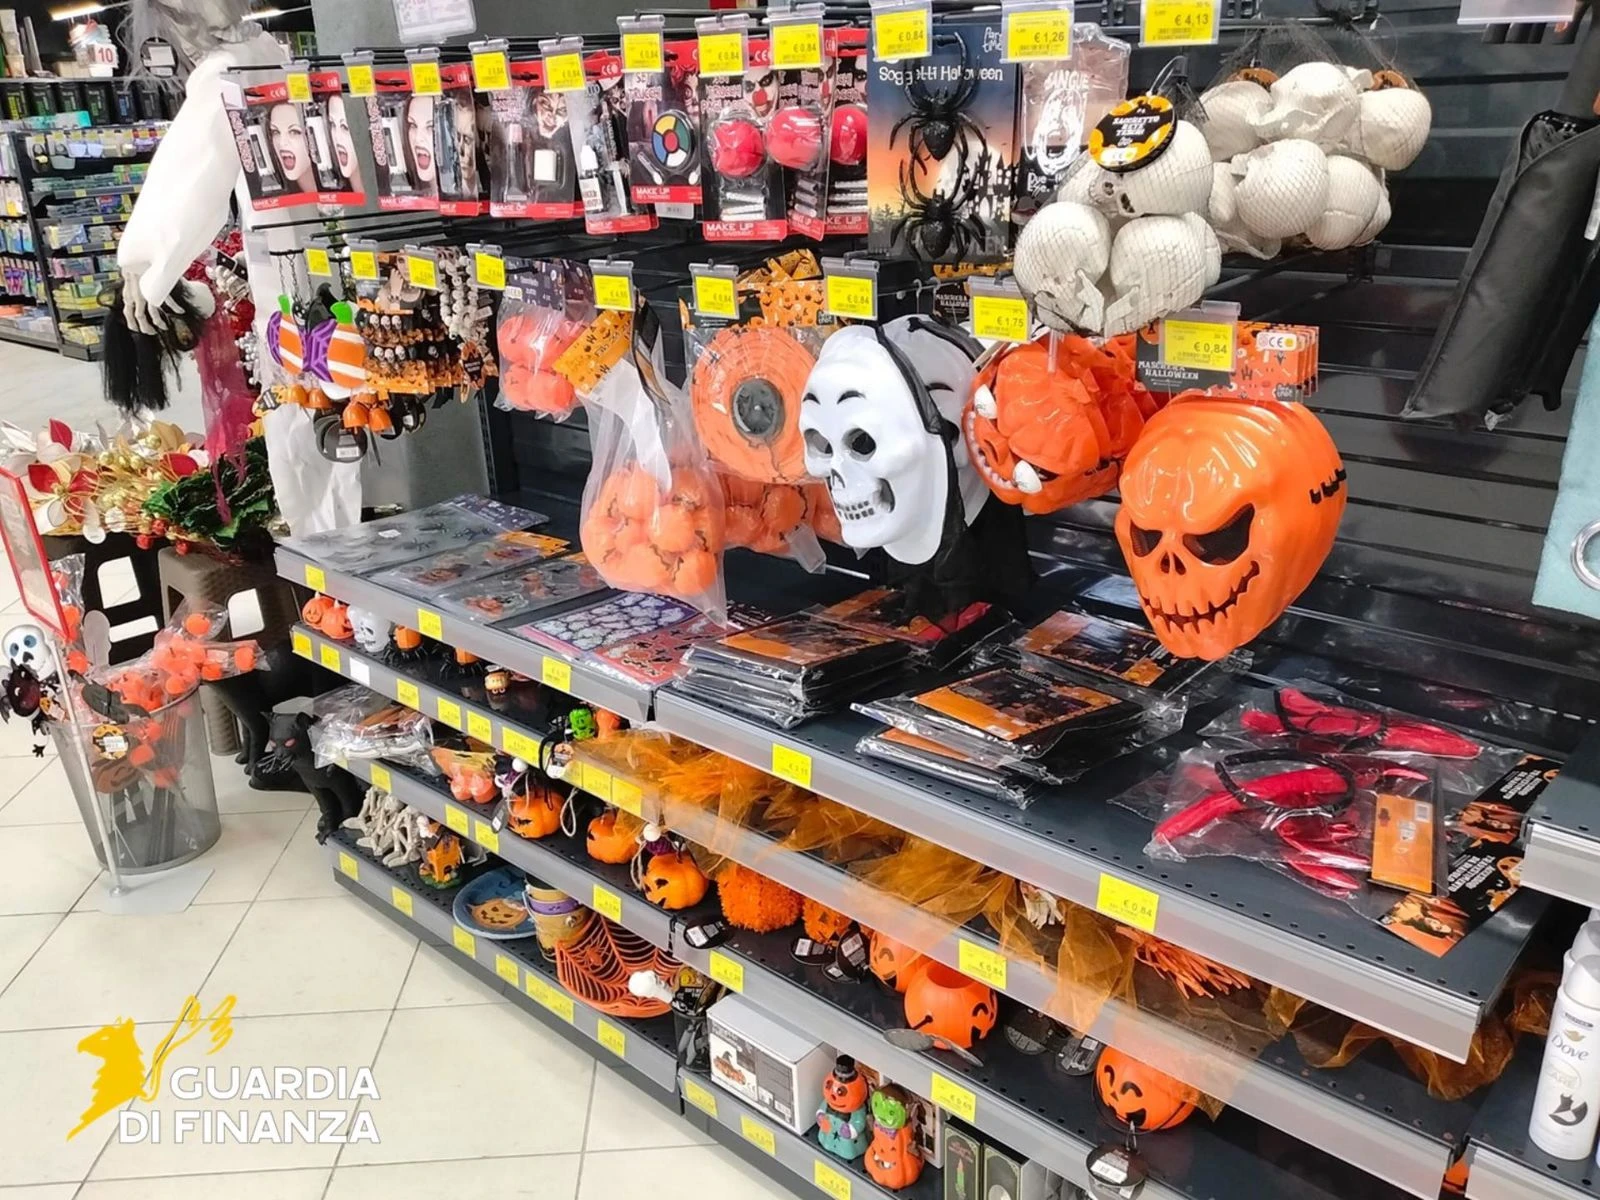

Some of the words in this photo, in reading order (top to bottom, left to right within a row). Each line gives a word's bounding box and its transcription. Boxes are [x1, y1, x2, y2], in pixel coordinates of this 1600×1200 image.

[1184, 13, 1209, 28] 4,13
[906, 30, 924, 42] 0,84
[1043, 31, 1065, 44] 1,26
[799, 42, 817, 52] 0,84
[98, 47, 114, 64] 10
[724, 52, 740, 60] 0,84
[706, 223, 736, 233] MAKE
[738, 222, 754, 232] UP
[1005, 317, 1024, 328] 1,75
[1203, 342, 1228, 354] 0,84
[1145, 368, 1199, 380] HALLOWEEN
[1551, 1033, 1590, 1061] Dove
